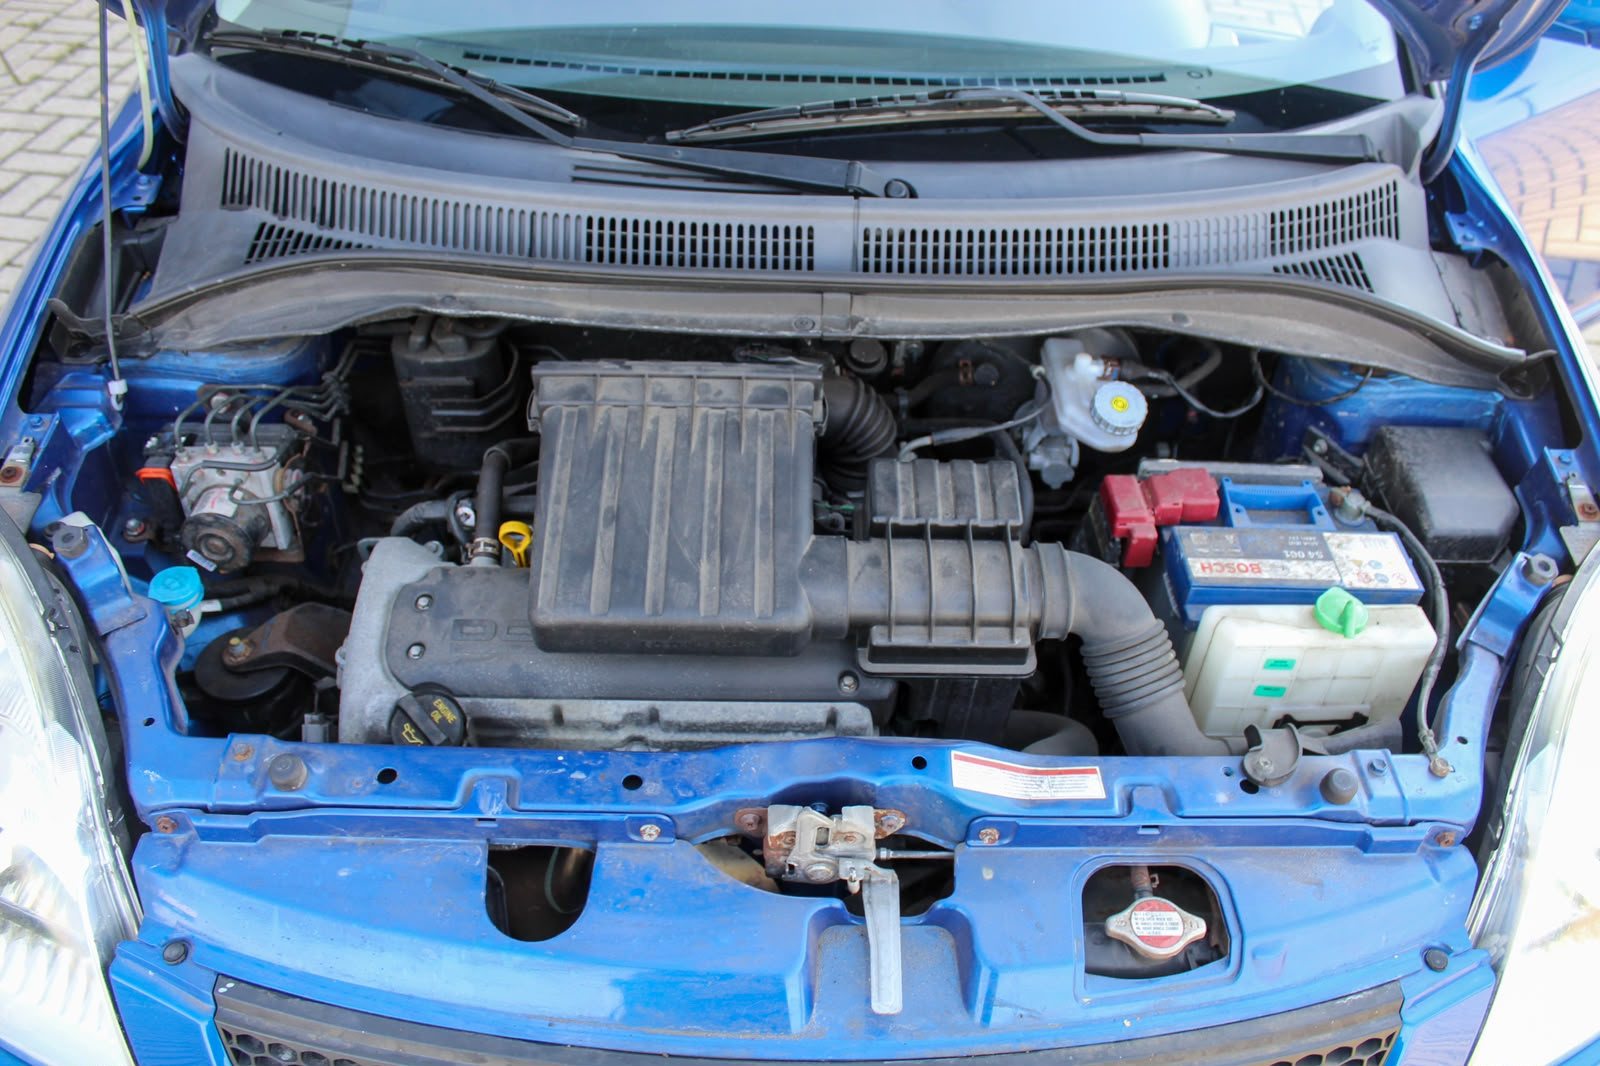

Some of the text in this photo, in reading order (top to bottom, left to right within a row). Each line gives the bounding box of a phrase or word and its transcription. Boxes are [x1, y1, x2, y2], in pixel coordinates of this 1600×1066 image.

[1200, 561, 1262, 574] BOSCH
[430, 710, 442, 724] OIL
[433, 699, 457, 724] ENGINE
